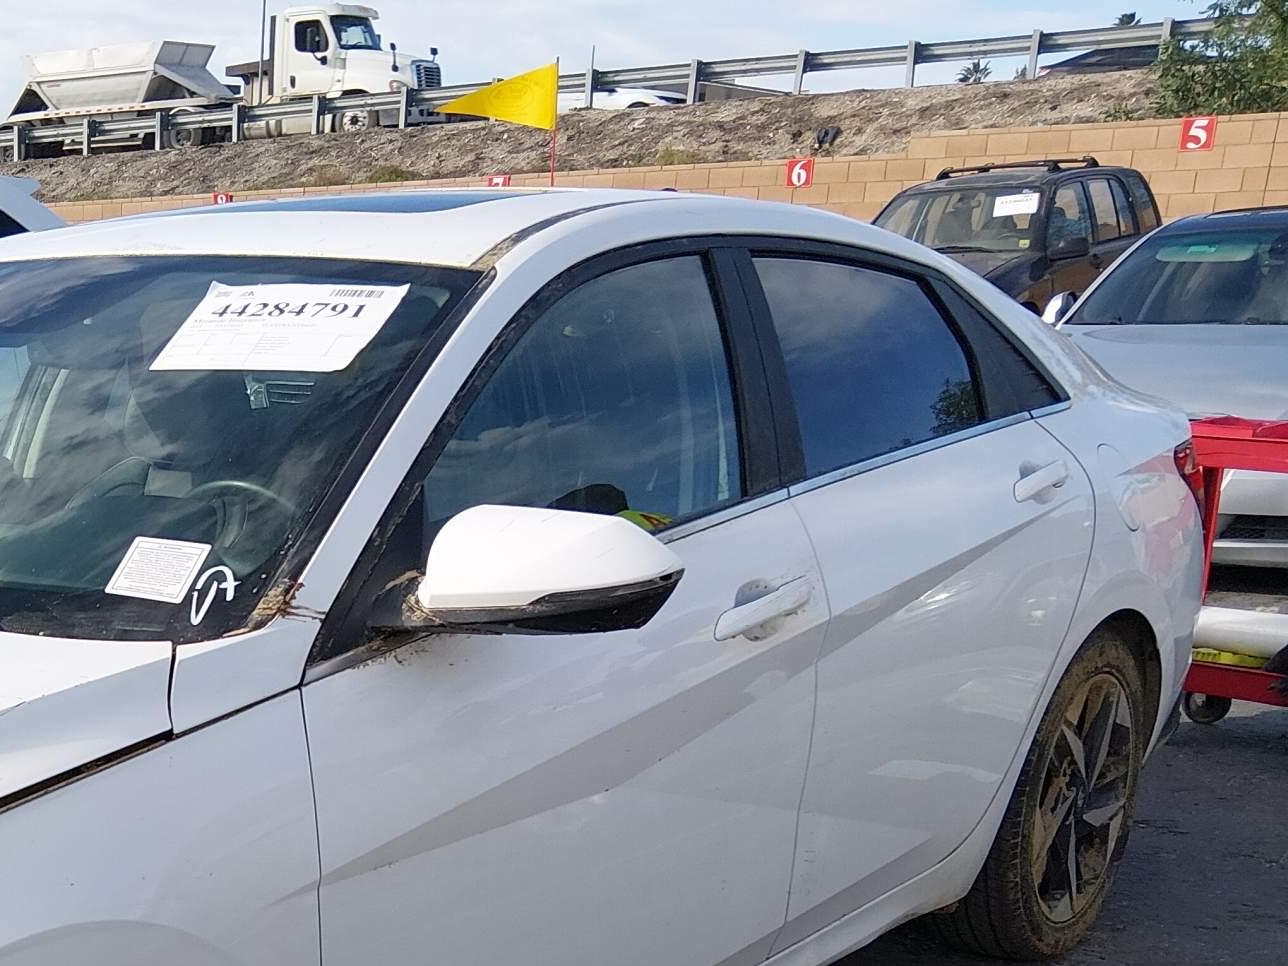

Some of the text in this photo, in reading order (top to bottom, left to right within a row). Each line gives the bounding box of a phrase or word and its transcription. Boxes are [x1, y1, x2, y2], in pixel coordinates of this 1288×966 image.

[1186, 119, 1210, 149] 5
[791, 160, 808, 187] 6
[212, 302, 366, 318] 44284791
